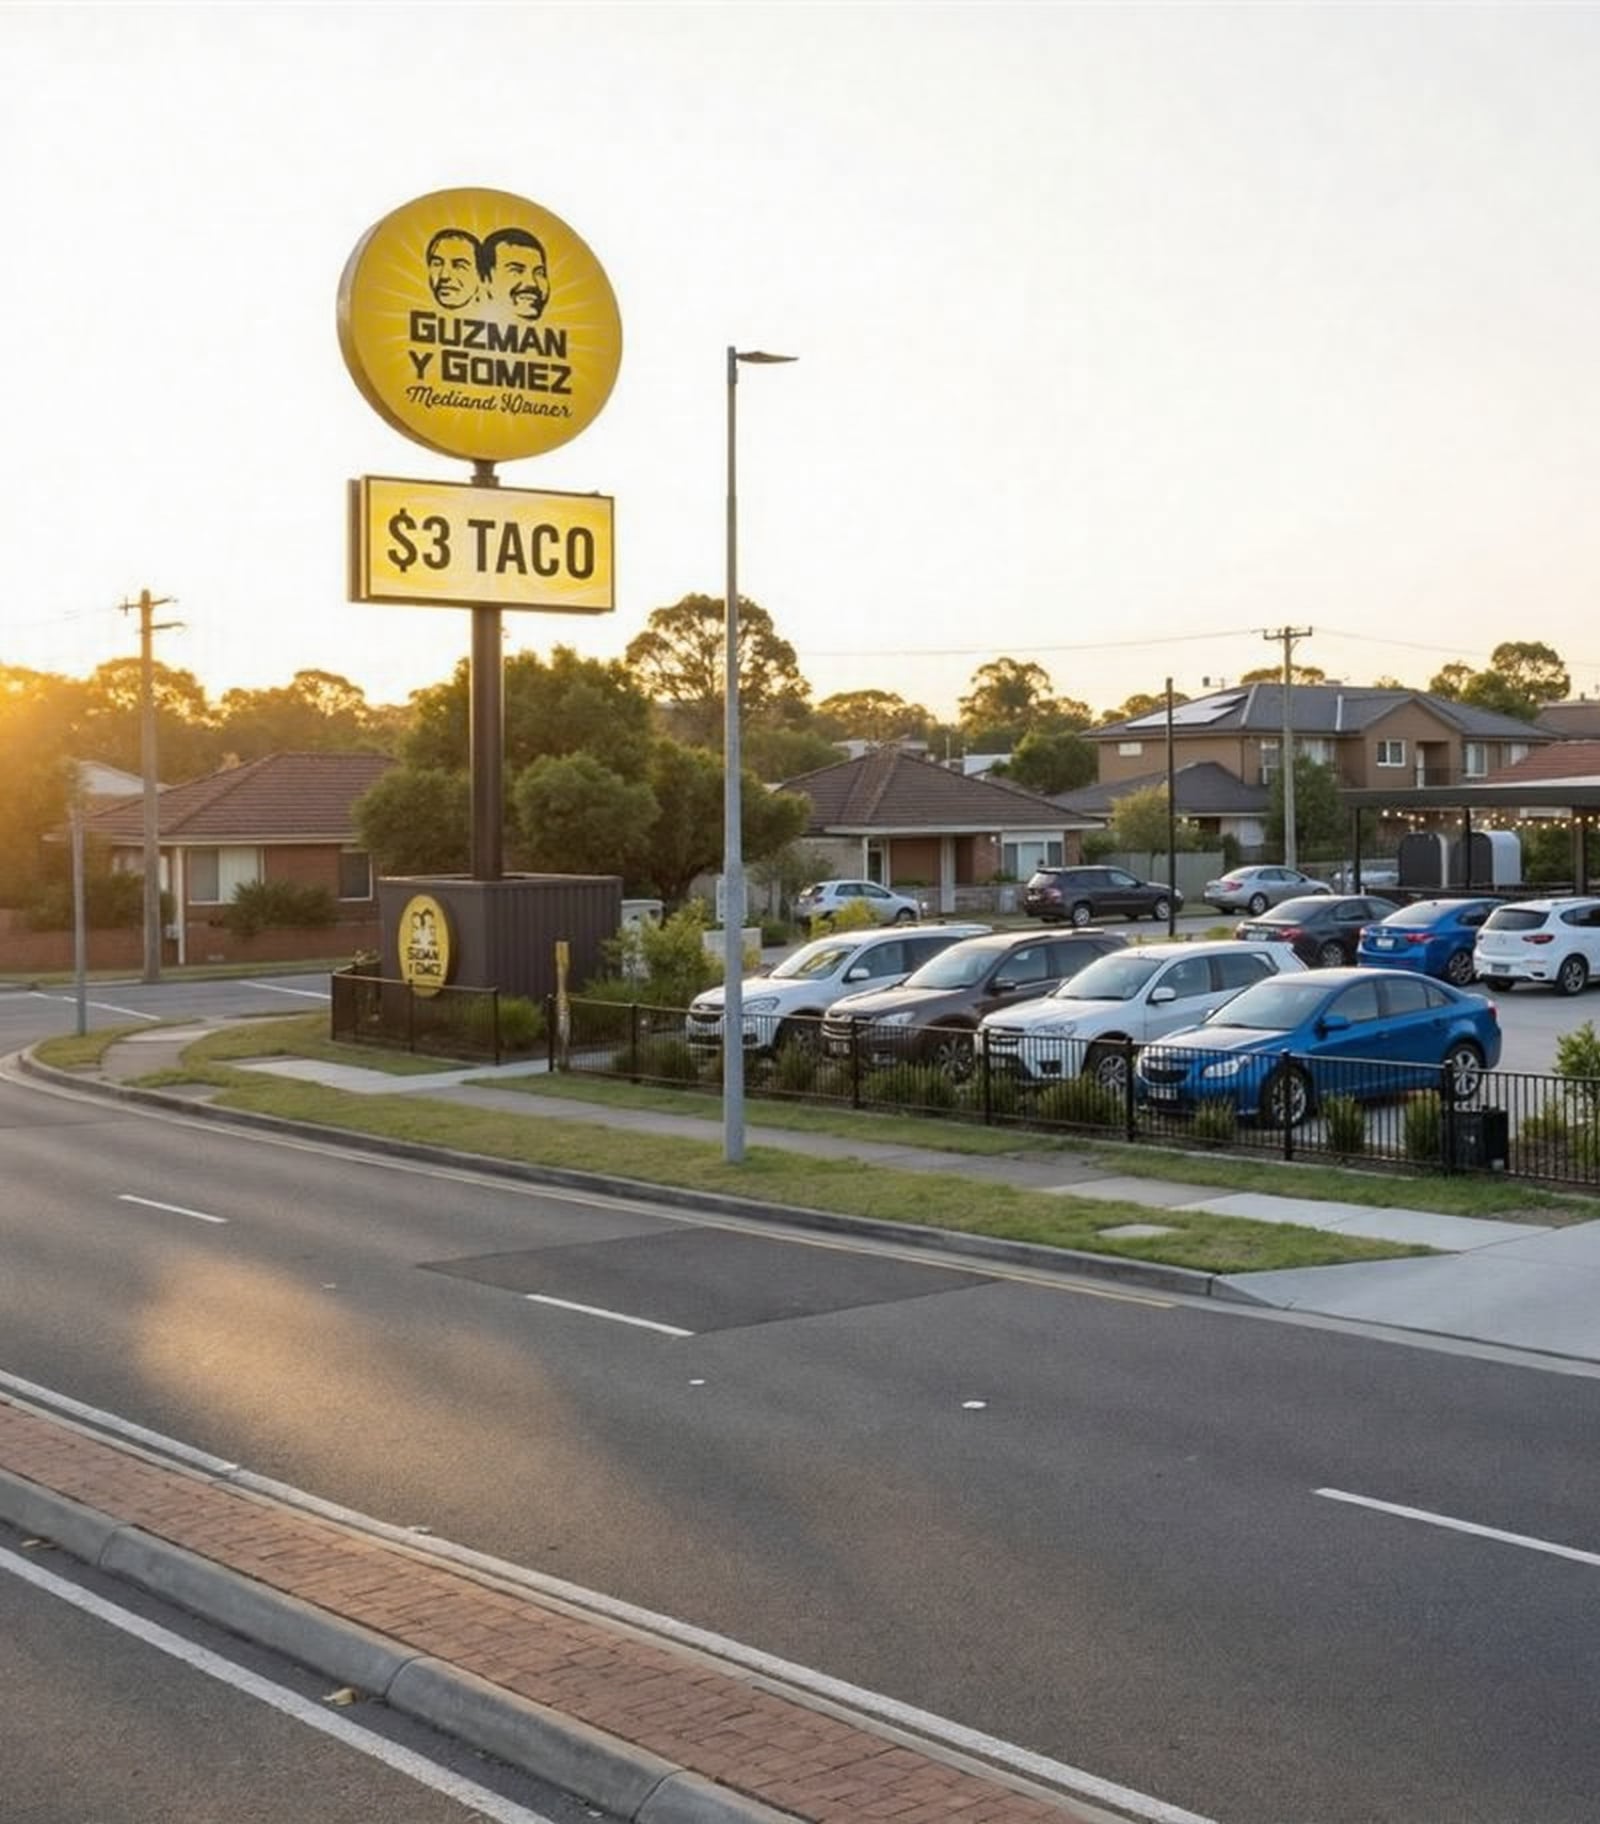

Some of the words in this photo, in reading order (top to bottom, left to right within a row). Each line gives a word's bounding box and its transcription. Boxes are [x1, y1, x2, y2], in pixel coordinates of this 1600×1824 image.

[410, 310, 568, 359] GUZMAN
[408, 350, 433, 380] Y
[441, 349, 572, 395] GOMEZ
[387, 508, 451, 573] $3
[467, 519, 595, 580] TACO
